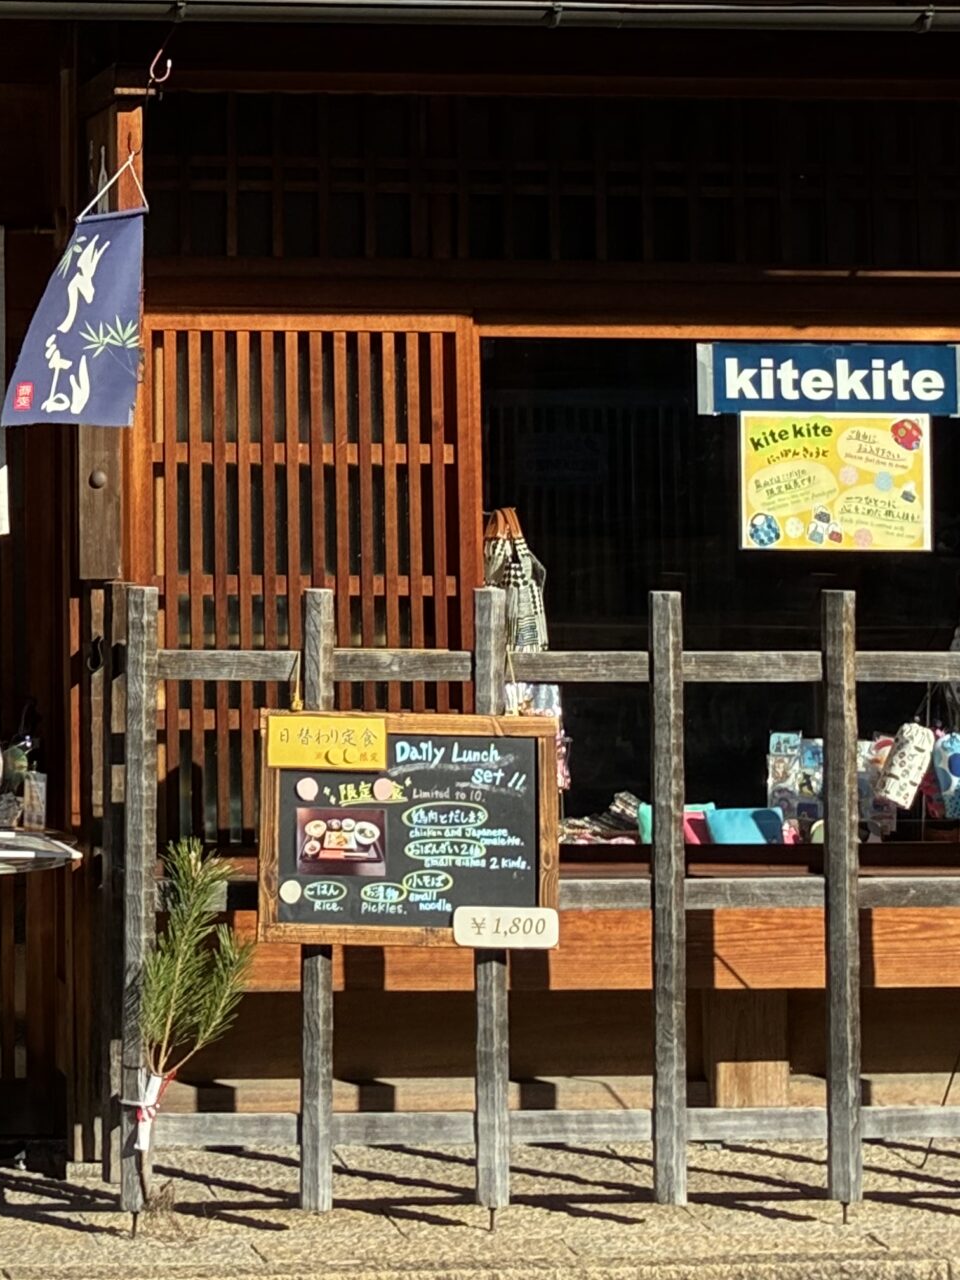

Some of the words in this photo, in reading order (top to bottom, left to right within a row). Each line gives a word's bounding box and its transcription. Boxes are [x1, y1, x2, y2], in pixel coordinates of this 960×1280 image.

[724, 357, 945, 401] kitekite
[749, 428, 790, 452] kite
[791, 422, 833, 439] kite
[279, 727, 378, 748] 日替わり定食
[395, 740, 445, 768] Daily
[451, 742, 500, 763] Lunch
[412, 786, 450, 799] Limited
[455, 791, 467, 801] to
[489, 859, 499, 870] 2
[306, 883, 340, 897] ごはん
[419, 898, 453, 912] noodle
